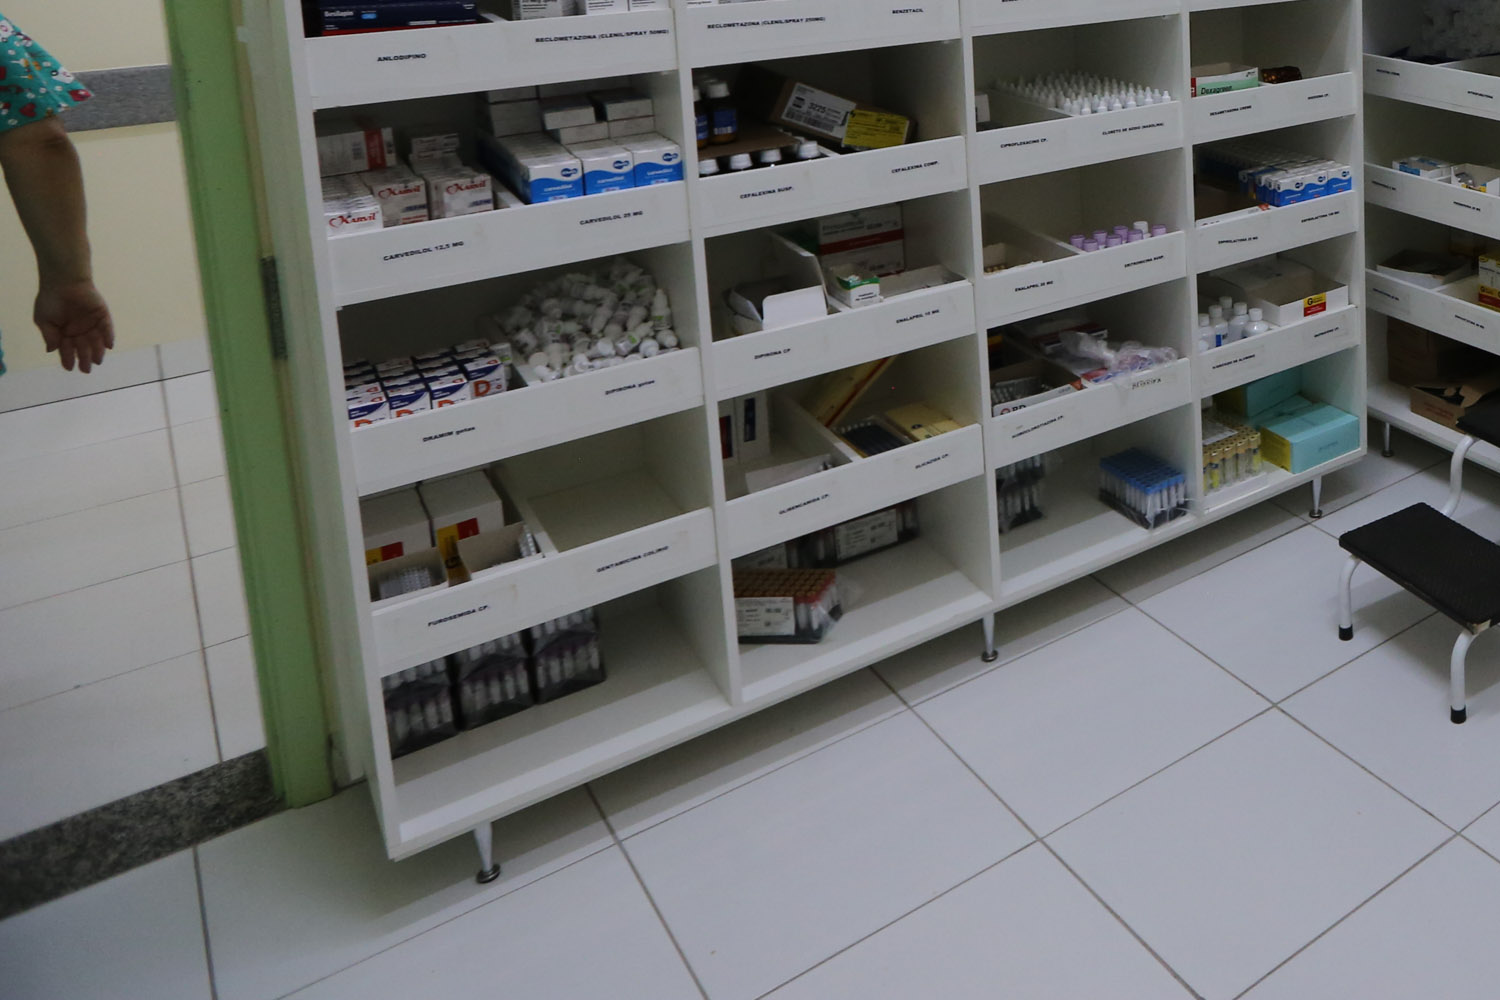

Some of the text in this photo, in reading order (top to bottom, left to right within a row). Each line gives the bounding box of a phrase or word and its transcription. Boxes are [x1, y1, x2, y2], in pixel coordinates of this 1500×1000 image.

[536, 35, 597, 43] BECLOMETAZONA
[892, 164, 922, 174] CEFALEXINA
[740, 188, 776, 199] CEFALEXINA
[580, 214, 622, 226] CARVEDILOL
[384, 248, 432, 261] CARVEDILOL
[422, 430, 454, 442] DRAMIN
[597, 554, 642, 572] GENTAMICINA
[428, 608, 476, 626] FUROSEMIDA
